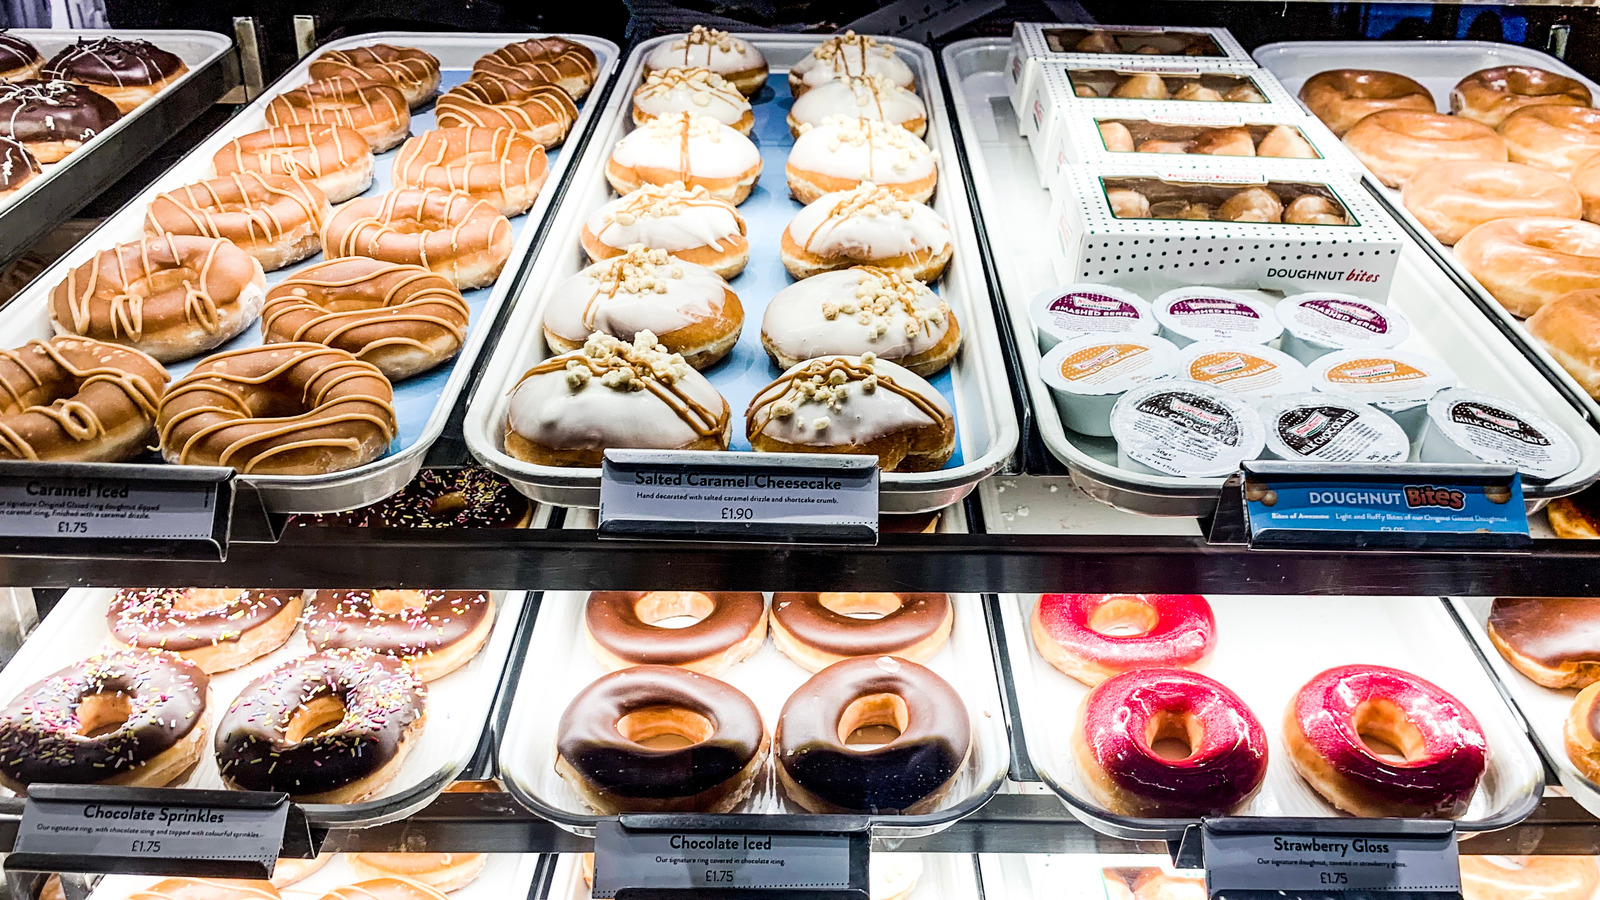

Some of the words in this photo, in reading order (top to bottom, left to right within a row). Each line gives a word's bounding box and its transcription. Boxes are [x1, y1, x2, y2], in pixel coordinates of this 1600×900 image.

[1266, 268, 1345, 281] DOUGHNUT
[1345, 268, 1380, 283] bites
[1054, 305, 1101, 317] SMASHED
[1223, 309, 1254, 318] BERRY
[1304, 302, 1350, 322] SMASHED
[1350, 318, 1384, 334] BERRY
[1231, 363, 1273, 378] CARAMEL
[1370, 372, 1424, 382] CARAMEL
[1140, 404, 1169, 417] MILK
[1168, 413, 1238, 446] CHOCOLATE
[1299, 440, 1318, 454] MILK
[1313, 410, 1356, 447] CHOCOLATE
[1455, 416, 1482, 428] MILK
[1483, 422, 1548, 444] CHOCOLATE
[635, 471, 682, 486] Salted
[687, 473, 749, 488] Caramel
[754, 474, 842, 490] Cheesecake
[26, 481, 91, 497] Caramel
[97, 482, 129, 498] Iced
[1309, 492, 1400, 504] DOUGHNUT
[1405, 485, 1464, 510] Bites
[721, 507, 753, 520] £1.90
[1335, 513, 1352, 521] Light
[58, 521, 88, 533] £1.75
[83, 804, 156, 820] Chocolate
[158, 807, 225, 826] Sprinkles
[36, 823, 50, 831] Our
[51, 825, 78, 833] signature
[80, 826, 94, 834] ring,
[140, 828, 155, 836] icing
[131, 840, 161, 853] £1.75
[669, 834, 739, 850] Chocolate
[743, 835, 772, 851] Iced
[1273, 837, 1348, 857] Strawberry
[1352, 839, 1390, 854] Gloss
[669, 857, 696, 865] signature
[697, 858, 709, 866] ring
[1257, 857, 1271, 865] Our
[1271, 859, 1298, 867] signature
[705, 870, 734, 882] £1.75
[1320, 872, 1348, 884] £1.75
